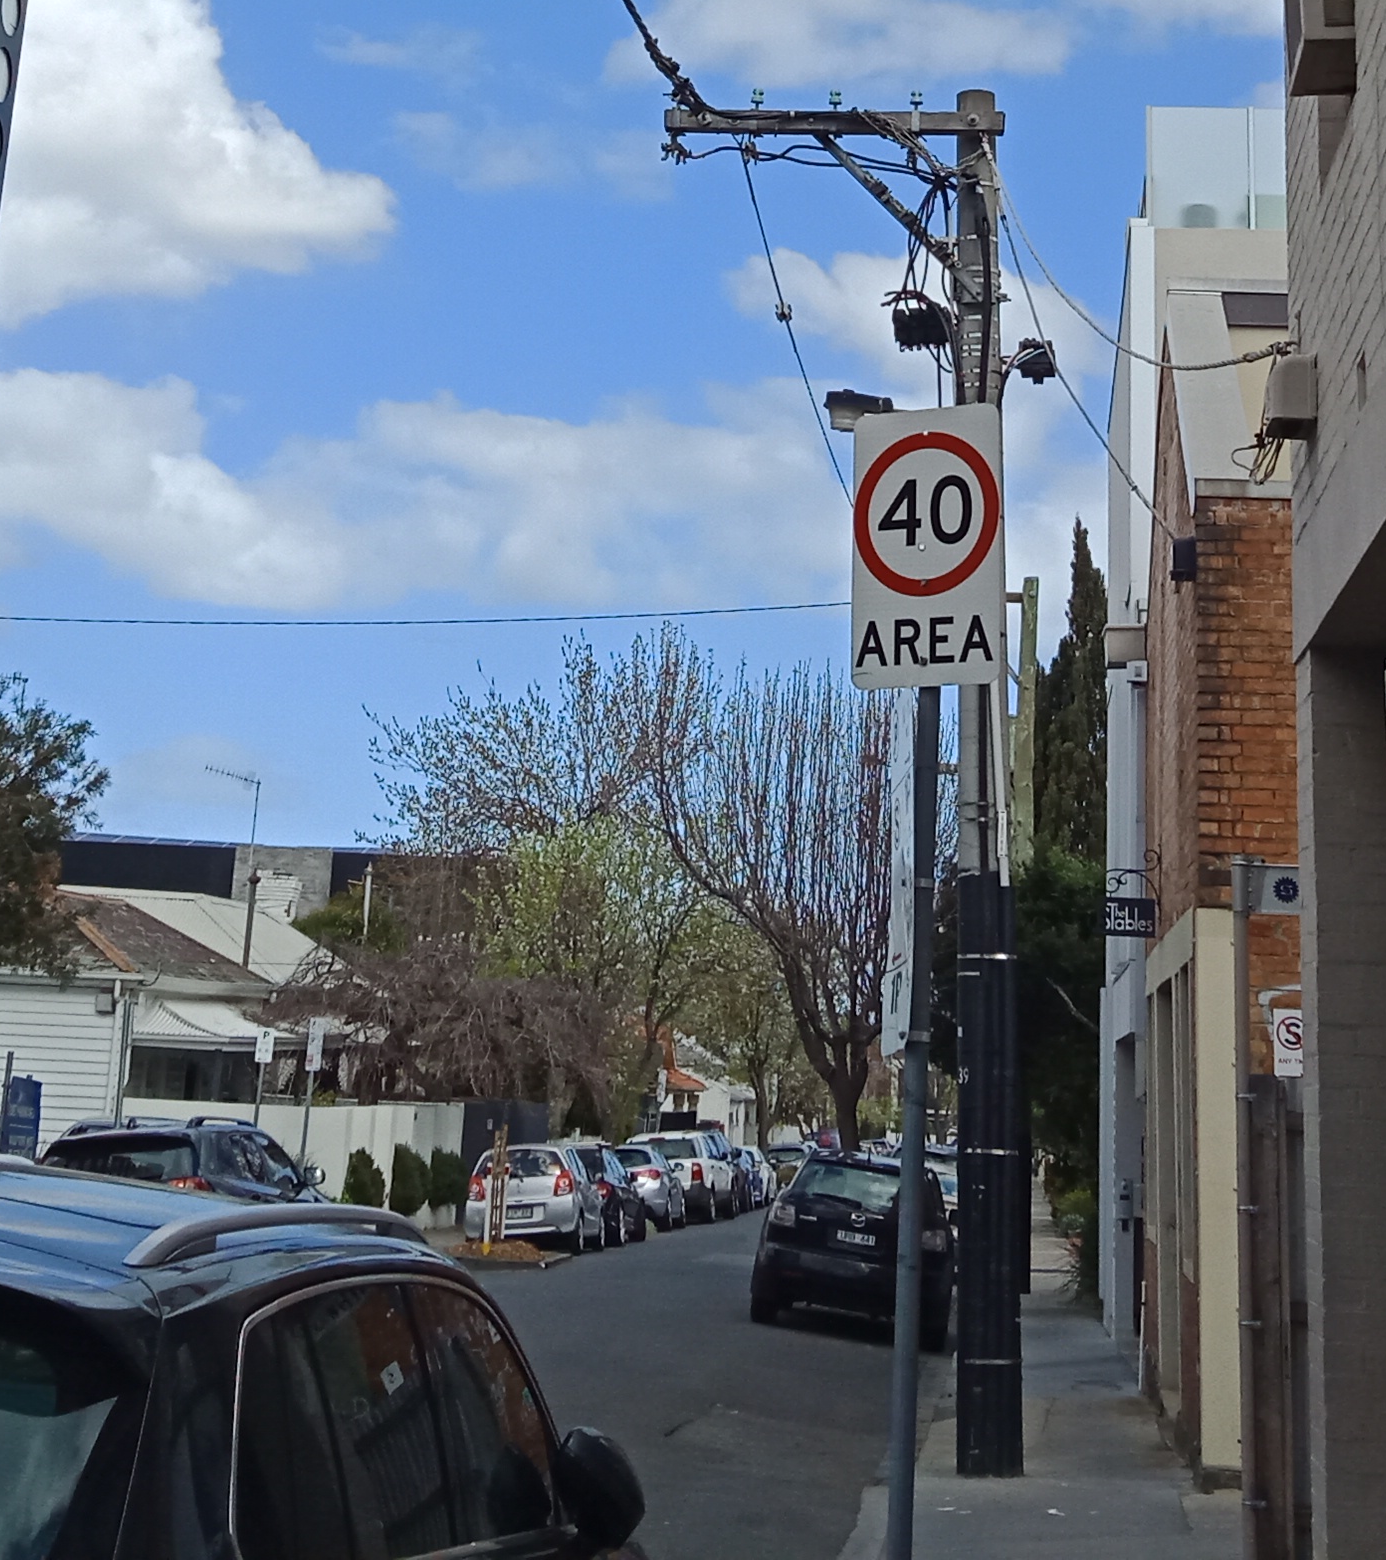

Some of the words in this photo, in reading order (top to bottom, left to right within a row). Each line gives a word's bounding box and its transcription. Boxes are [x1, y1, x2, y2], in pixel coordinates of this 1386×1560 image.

[877, 474, 973, 547] 40
[855, 613, 994, 668] AREA
[1278, 1057, 1293, 1065] ANY
